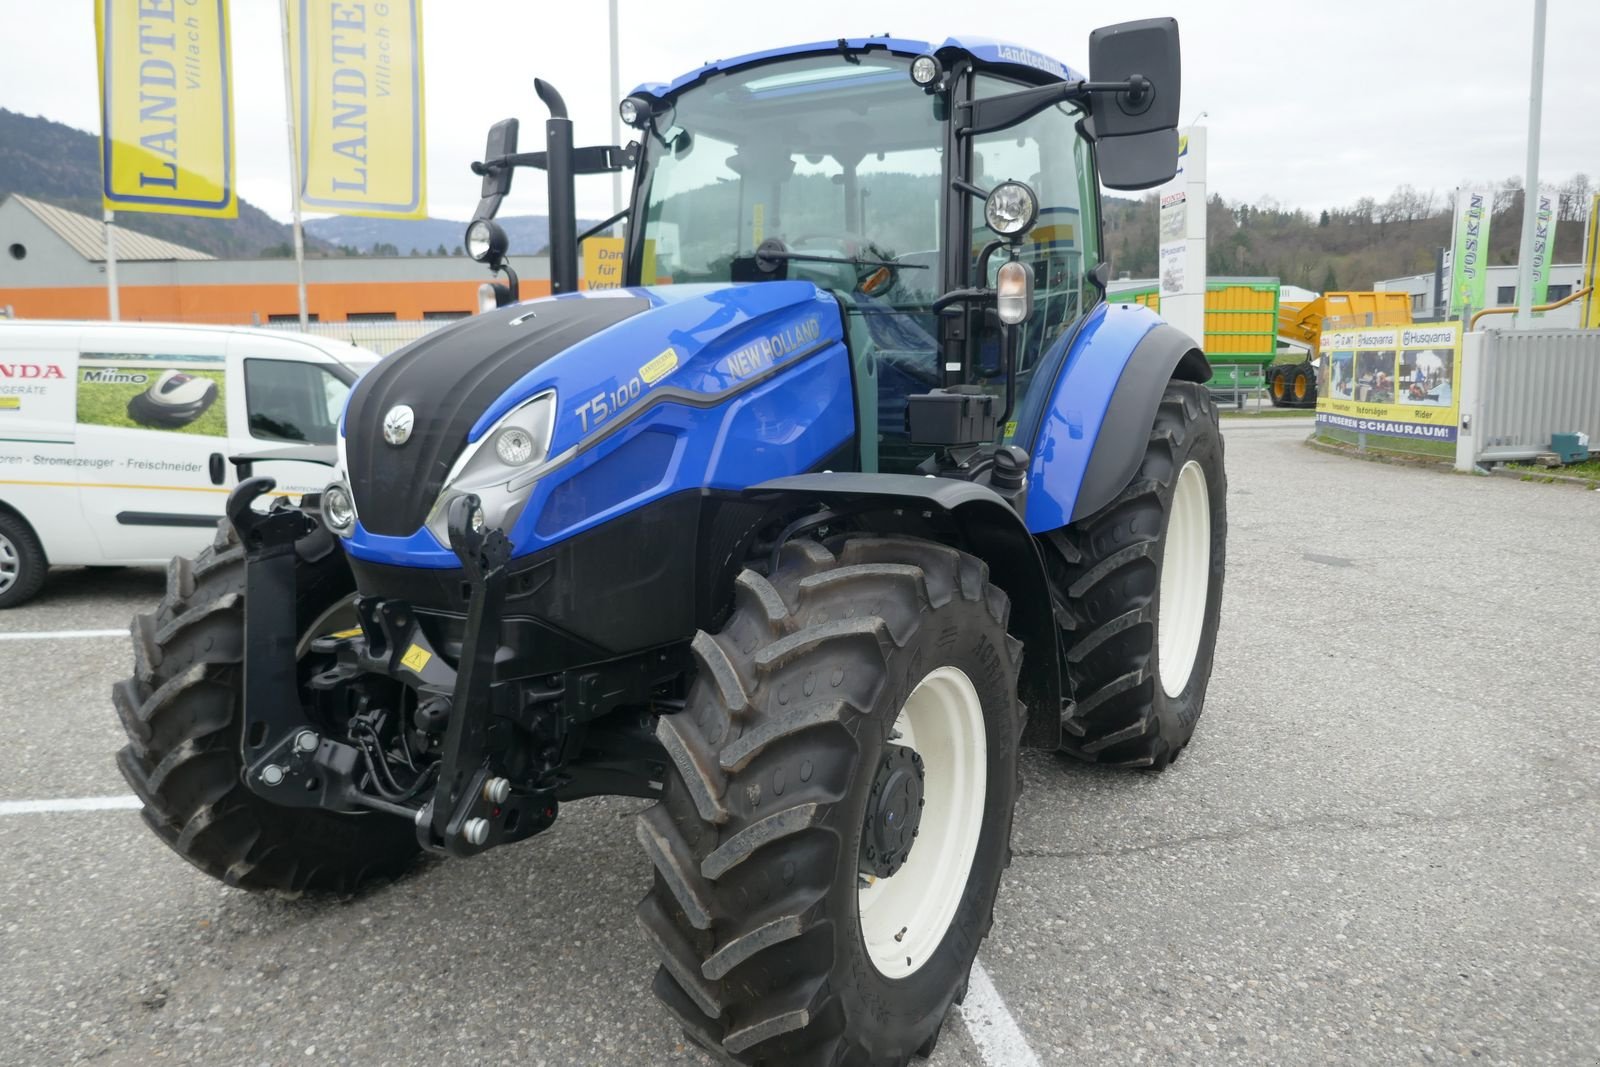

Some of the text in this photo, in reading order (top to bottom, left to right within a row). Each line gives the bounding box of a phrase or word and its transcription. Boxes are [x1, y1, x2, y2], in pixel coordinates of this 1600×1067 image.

[184, 16, 201, 92] Villach
[375, 27, 391, 98] Villach
[331, 3, 367, 195] LANDTE
[1463, 192, 1484, 280] JOSKIN
[1532, 195, 1552, 282] JOSKIN
[598, 264, 616, 275] für
[726, 340, 767, 381] NEW
[765, 317, 821, 365] HOLLAND
[1410, 331, 1452, 346] Husqvarna
[83, 368, 148, 384] Miimo
[575, 376, 641, 432] T5.100
[1328, 414, 1358, 429] UNSEREN
[1358, 420, 1449, 438] SCHAURAUM!
[1414, 409, 1433, 419] Rider
[33, 454, 114, 470] Stromerzeuger
[126, 457, 203, 473] Freischneider
